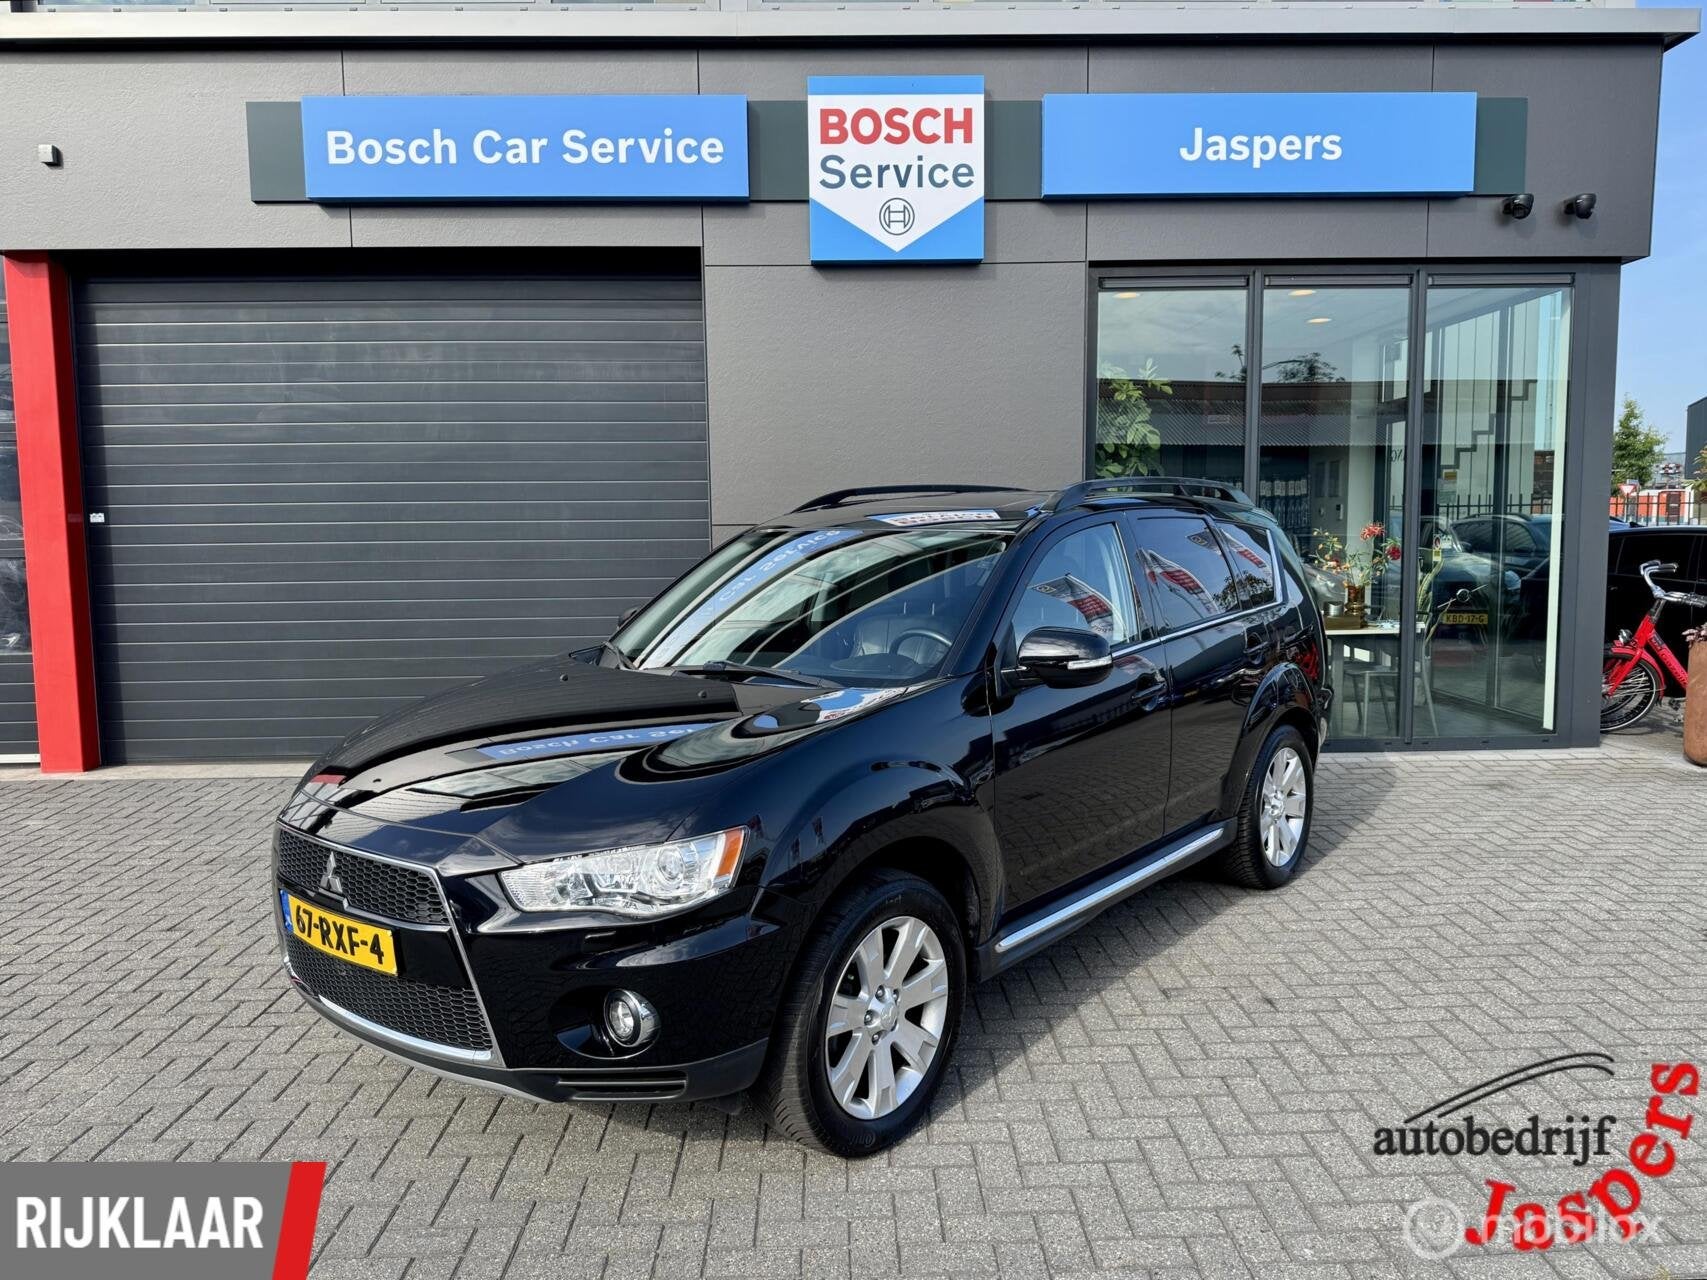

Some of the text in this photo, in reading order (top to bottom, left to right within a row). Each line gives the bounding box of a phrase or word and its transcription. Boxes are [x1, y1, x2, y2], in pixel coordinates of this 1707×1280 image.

[819, 107, 974, 145] BOSCH
[326, 127, 724, 165] Bosch Car Service
[1179, 127, 1342, 169] Jaspers
[819, 154, 975, 190] Service
[295, 904, 385, 965] 67-RXF-4
